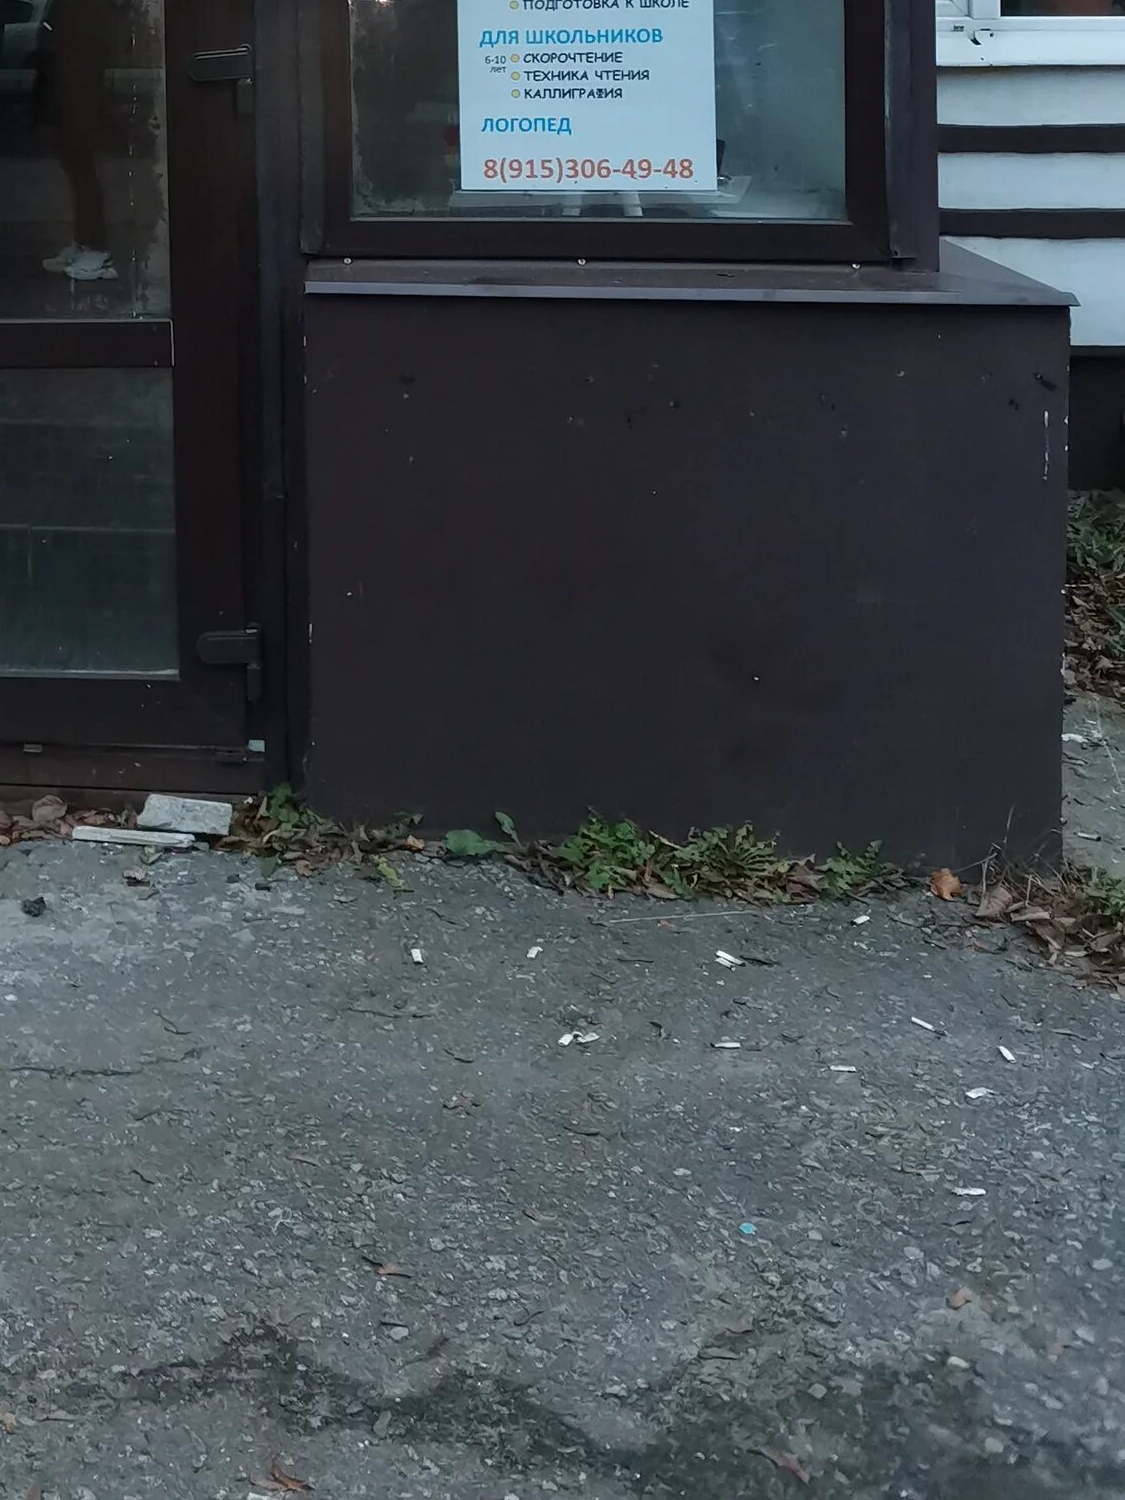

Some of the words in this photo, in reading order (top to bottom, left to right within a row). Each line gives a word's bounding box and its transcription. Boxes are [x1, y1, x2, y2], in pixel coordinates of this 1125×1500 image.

[479, 30, 519, 49] ДЛЯ
[525, 27, 664, 46] ШКОЛЬНИКОВ
[484, 54, 507, 66] 6-10
[523, 51, 623, 65] СКОРОЧТЕНИЕ
[489, 65, 507, 75] лет
[523, 69, 589, 82] ТЕХНИКА
[594, 68, 650, 82] ЧТЕНИЯ
[523, 86, 623, 100] КАЛЛИГРАФИЯ
[480, 117, 572, 136] ЛОГОПЕД
[483, 155, 694, 184] 8(915)306-49-48
